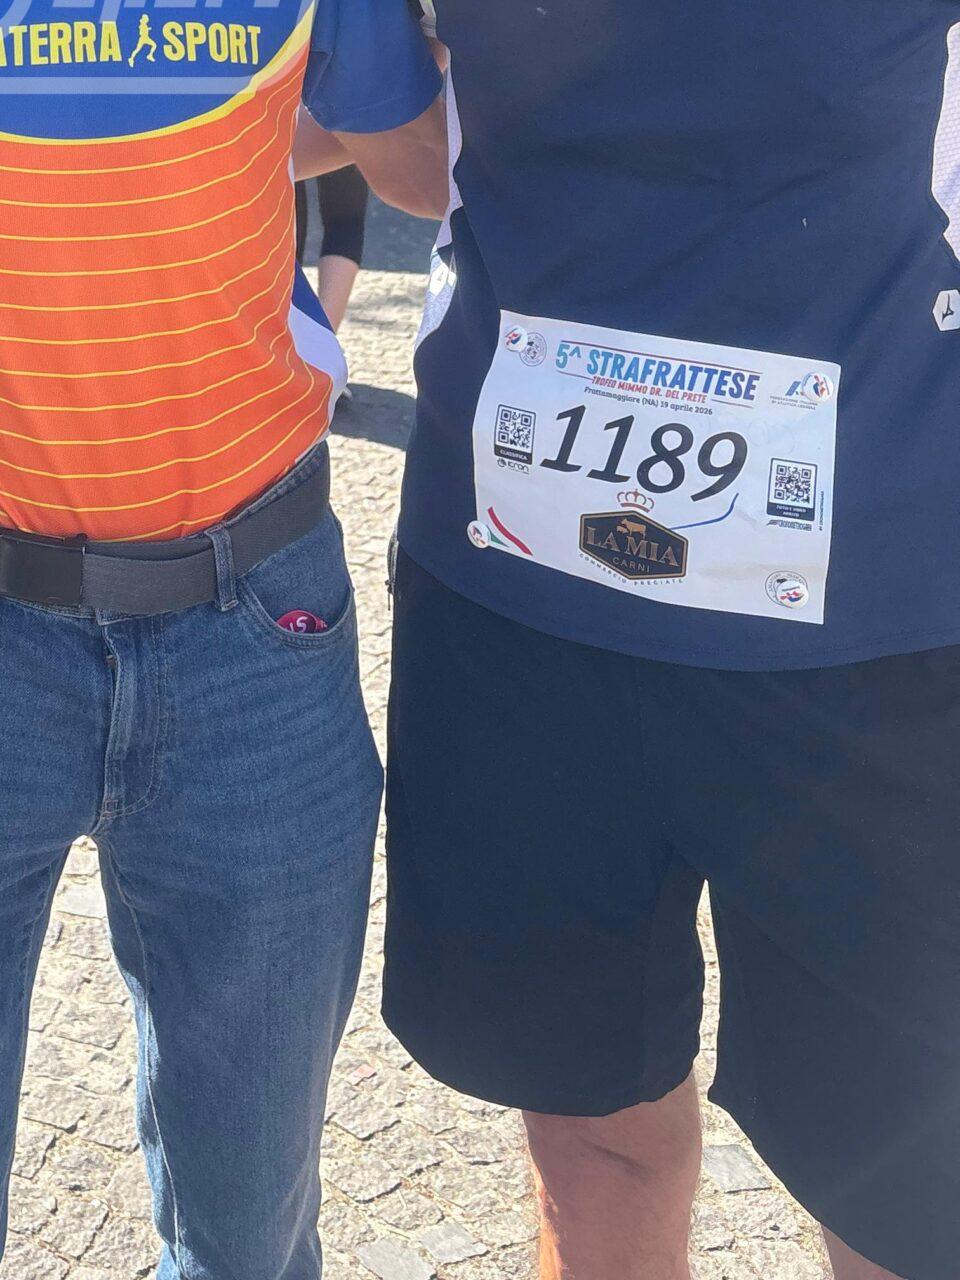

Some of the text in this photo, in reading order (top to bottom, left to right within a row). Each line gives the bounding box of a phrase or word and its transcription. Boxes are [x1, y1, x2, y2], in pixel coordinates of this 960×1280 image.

[162, 21, 262, 65] SPORT
[587, 348, 761, 401] STRAFRATTESE
[591, 375, 707, 404] TROFEO MIMMO DR. DEL PRETE
[583, 386, 713, 415] Frattamaggiore (NA) 19 aprile 2026
[539, 404, 748, 502] 1189
[586, 526, 680, 567] LA MIA
[612, 556, 650, 573] CARNI
